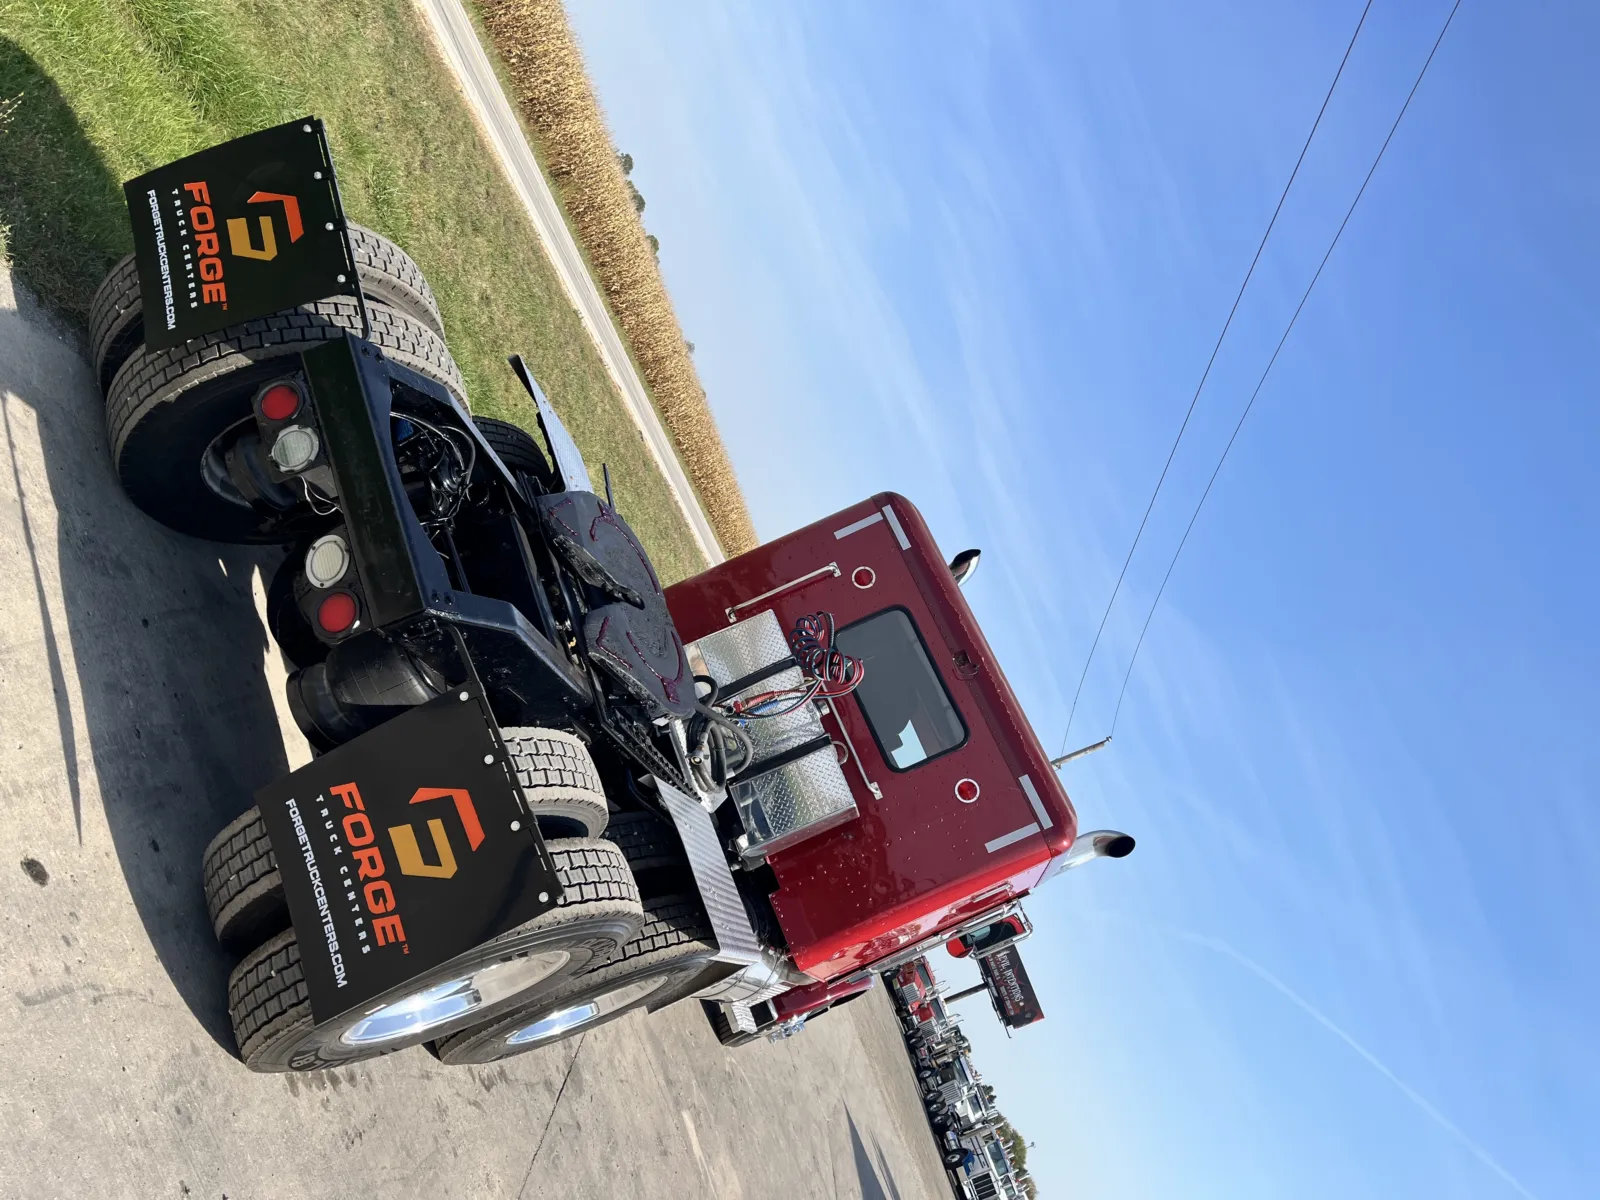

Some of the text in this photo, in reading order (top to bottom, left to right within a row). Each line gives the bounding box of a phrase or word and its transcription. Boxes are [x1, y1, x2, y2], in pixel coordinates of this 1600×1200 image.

[147, 189, 176, 330] FORGETRUCKCENTERS.COM
[171, 188, 198, 309] TRUCK CENTERS
[184, 181, 227, 304] FORGE
[285, 798, 348, 988] FORGETRUCKCENTERS.COM
[315, 794, 371, 954] TRUCK CENTERS
[329, 781, 406, 947] FORGE
